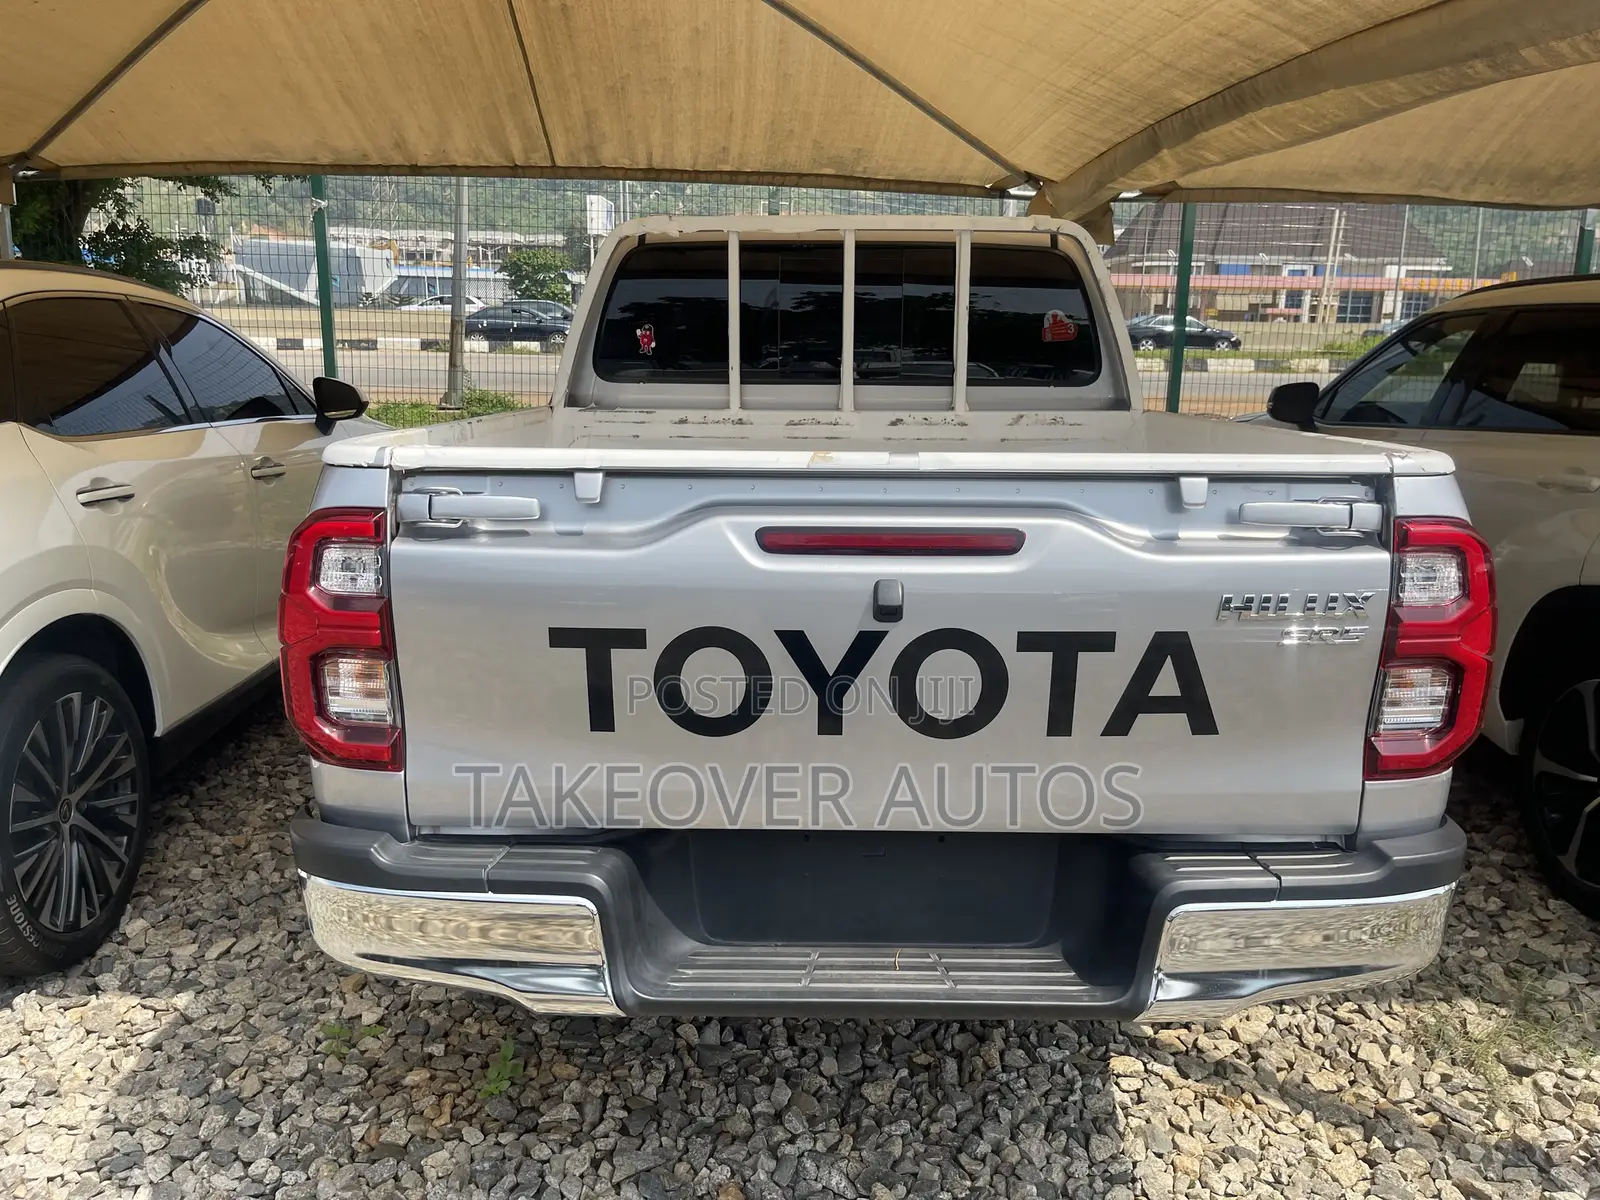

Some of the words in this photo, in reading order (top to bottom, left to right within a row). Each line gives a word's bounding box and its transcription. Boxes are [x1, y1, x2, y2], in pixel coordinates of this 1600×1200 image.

[1067, 323, 1075, 334] 3
[1216, 592, 1376, 621] HILUX
[549, 626, 1219, 738] TOYOTA
